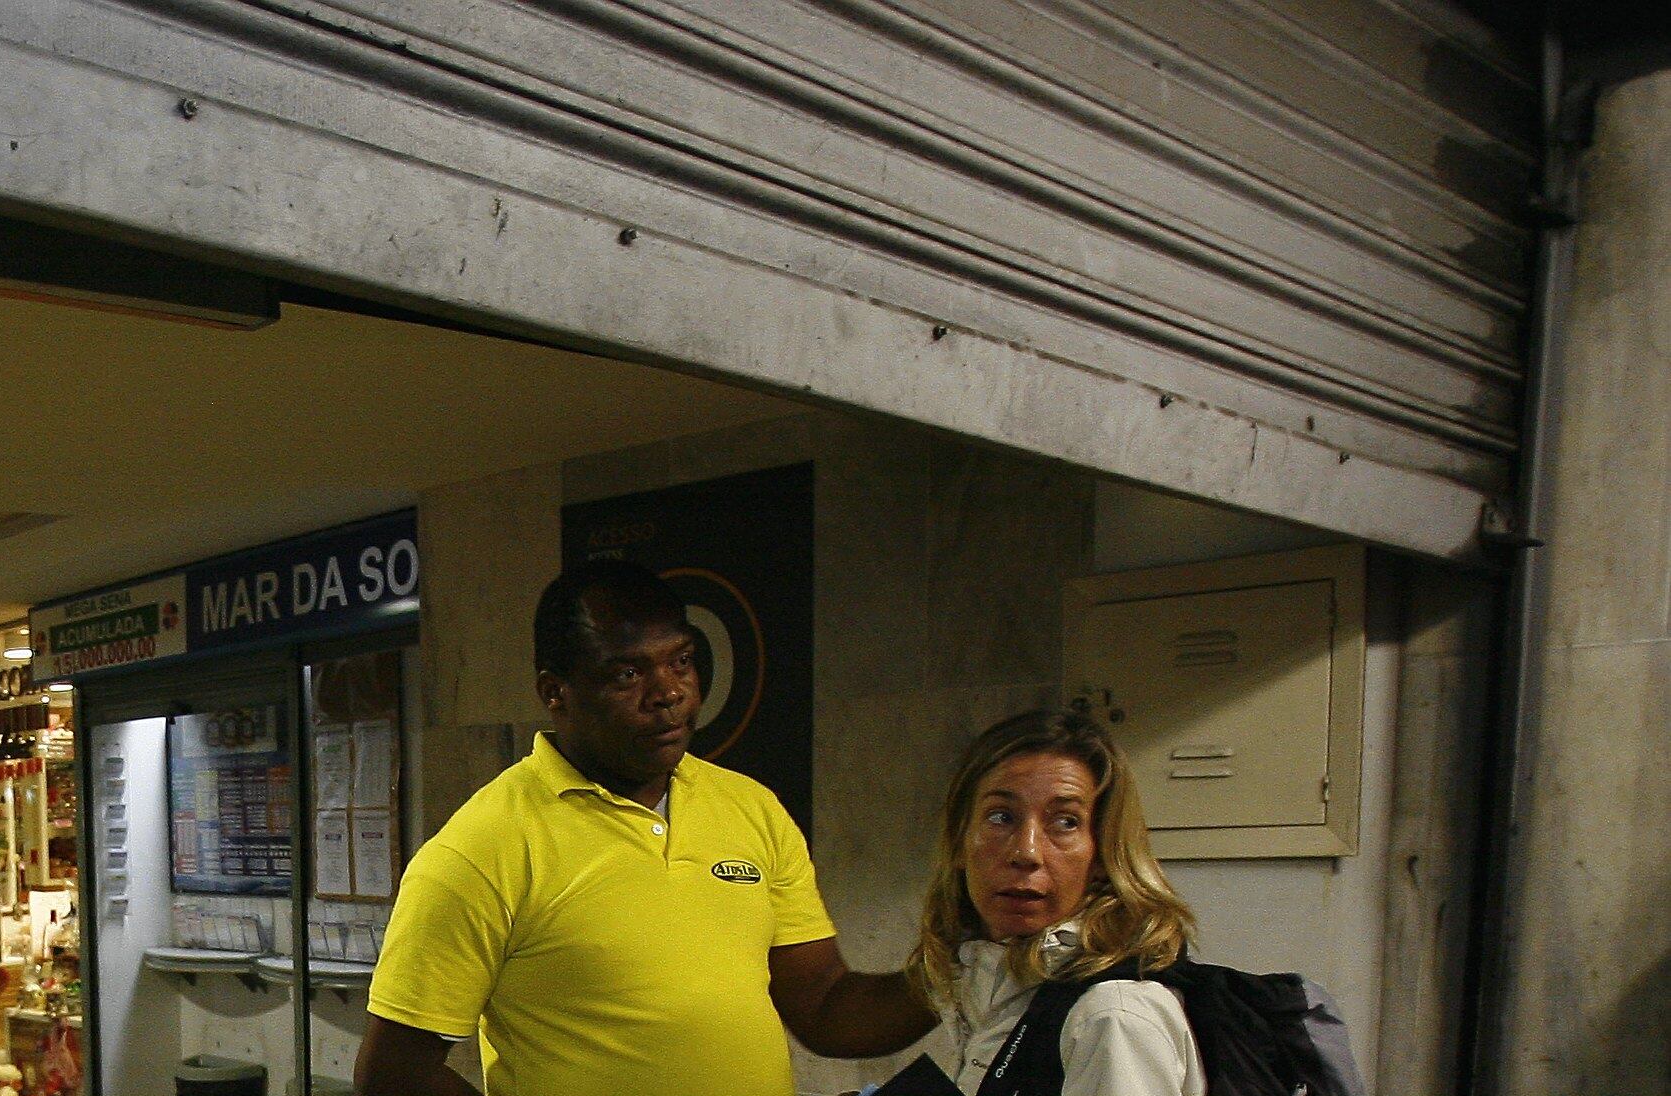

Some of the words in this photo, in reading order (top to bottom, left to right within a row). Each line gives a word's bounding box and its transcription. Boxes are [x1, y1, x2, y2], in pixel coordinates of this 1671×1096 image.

[99, 590, 132, 611] SENA
[202, 572, 280, 632] MAR
[293, 555, 347, 614] DA
[359, 539, 419, 601] SO
[58, 615, 145, 646] ACUMULADA
[995, 1024, 1027, 1078] Quechua
